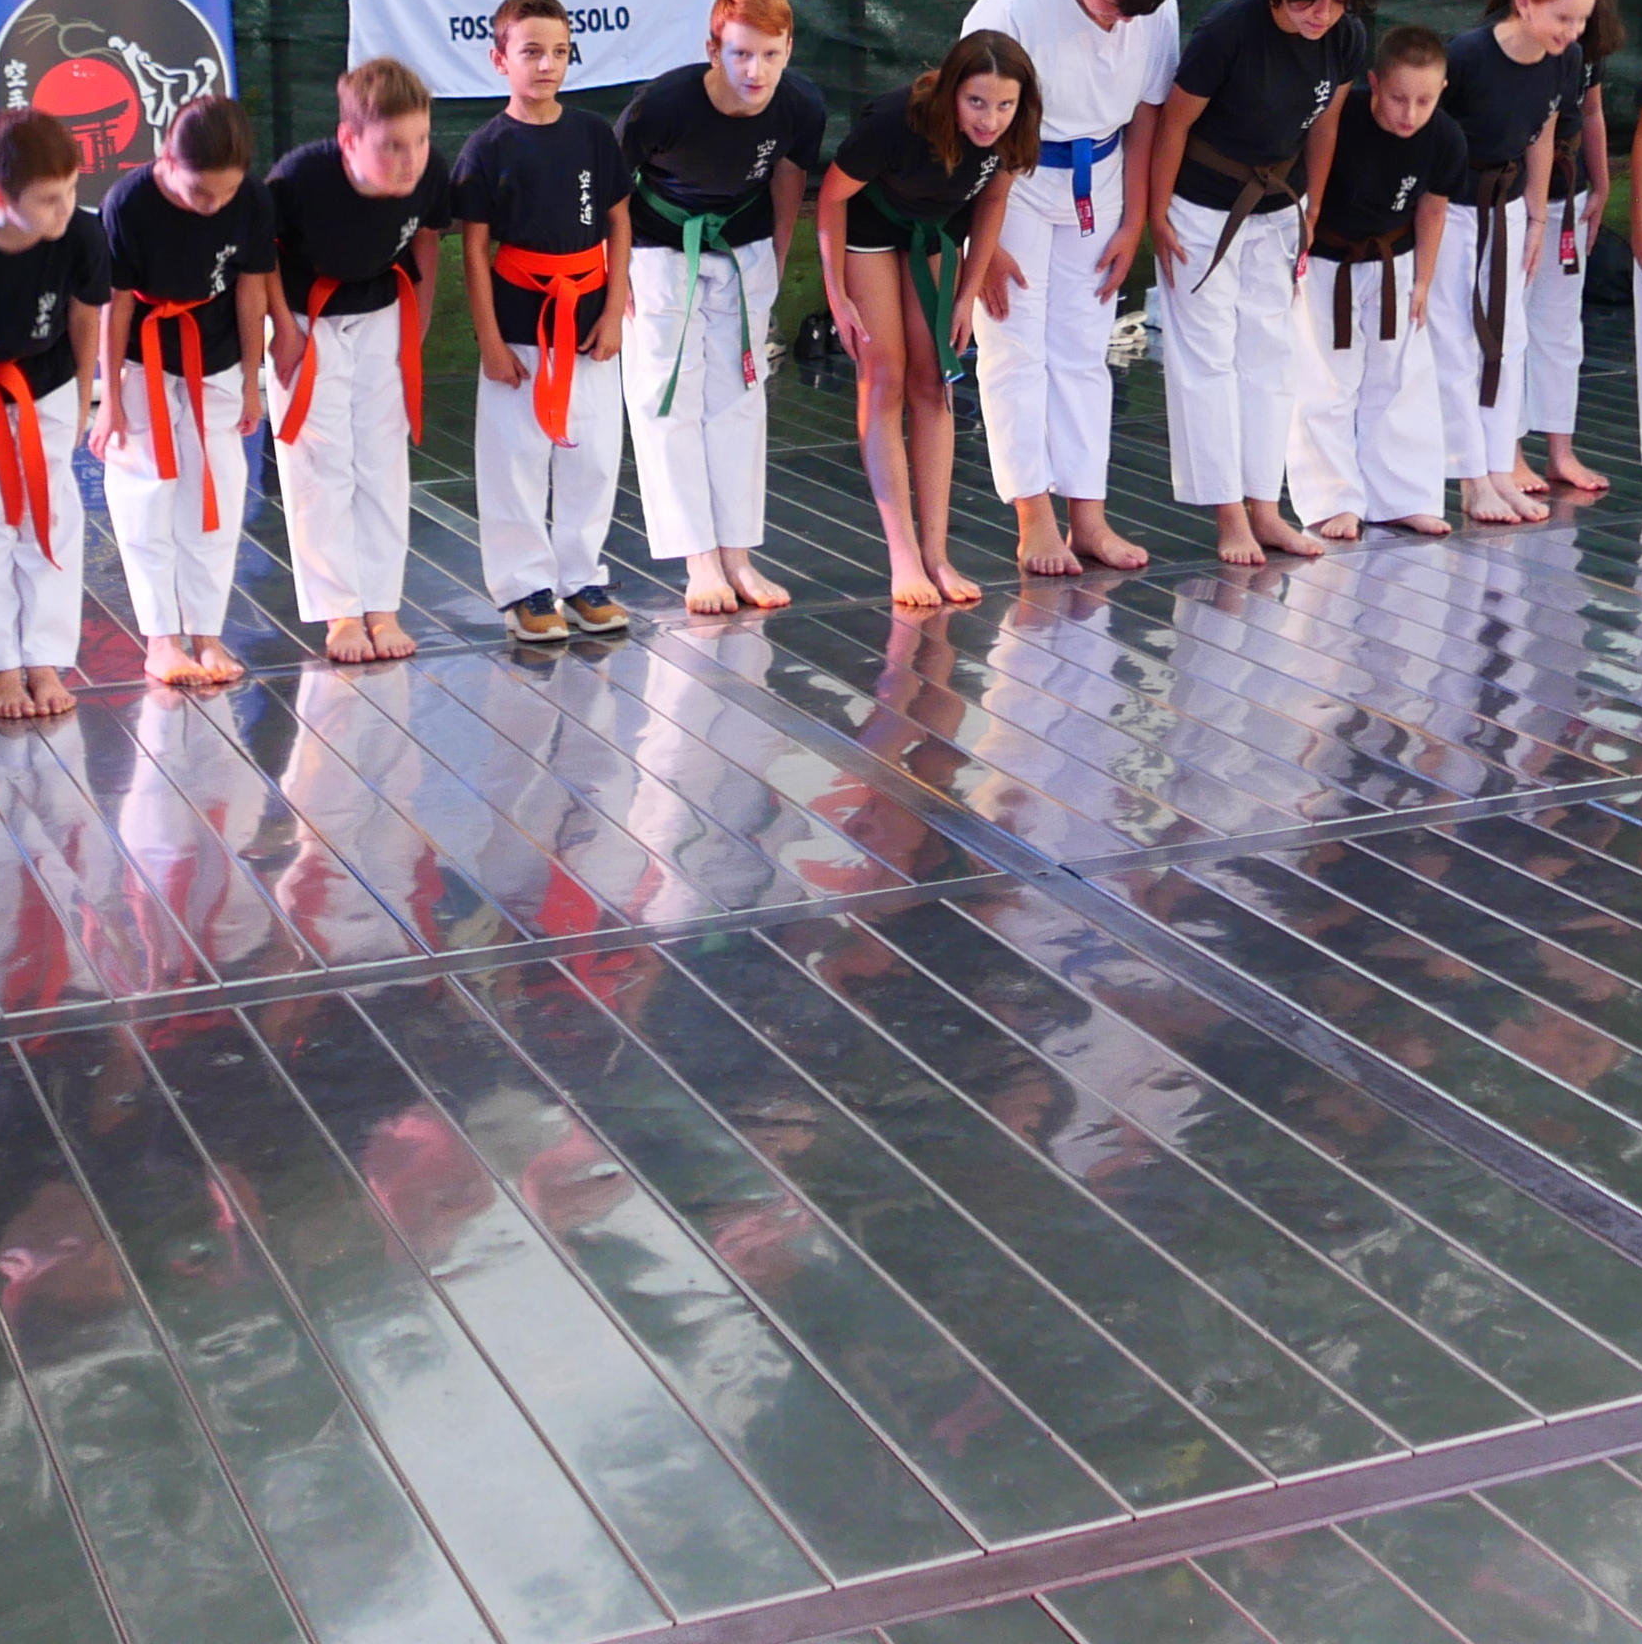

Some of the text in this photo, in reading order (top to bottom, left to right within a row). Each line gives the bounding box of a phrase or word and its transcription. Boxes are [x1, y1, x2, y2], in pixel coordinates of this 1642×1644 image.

[449, 6, 630, 42] FOSS ESOLO
[578, 168, 593, 226] 空手道
